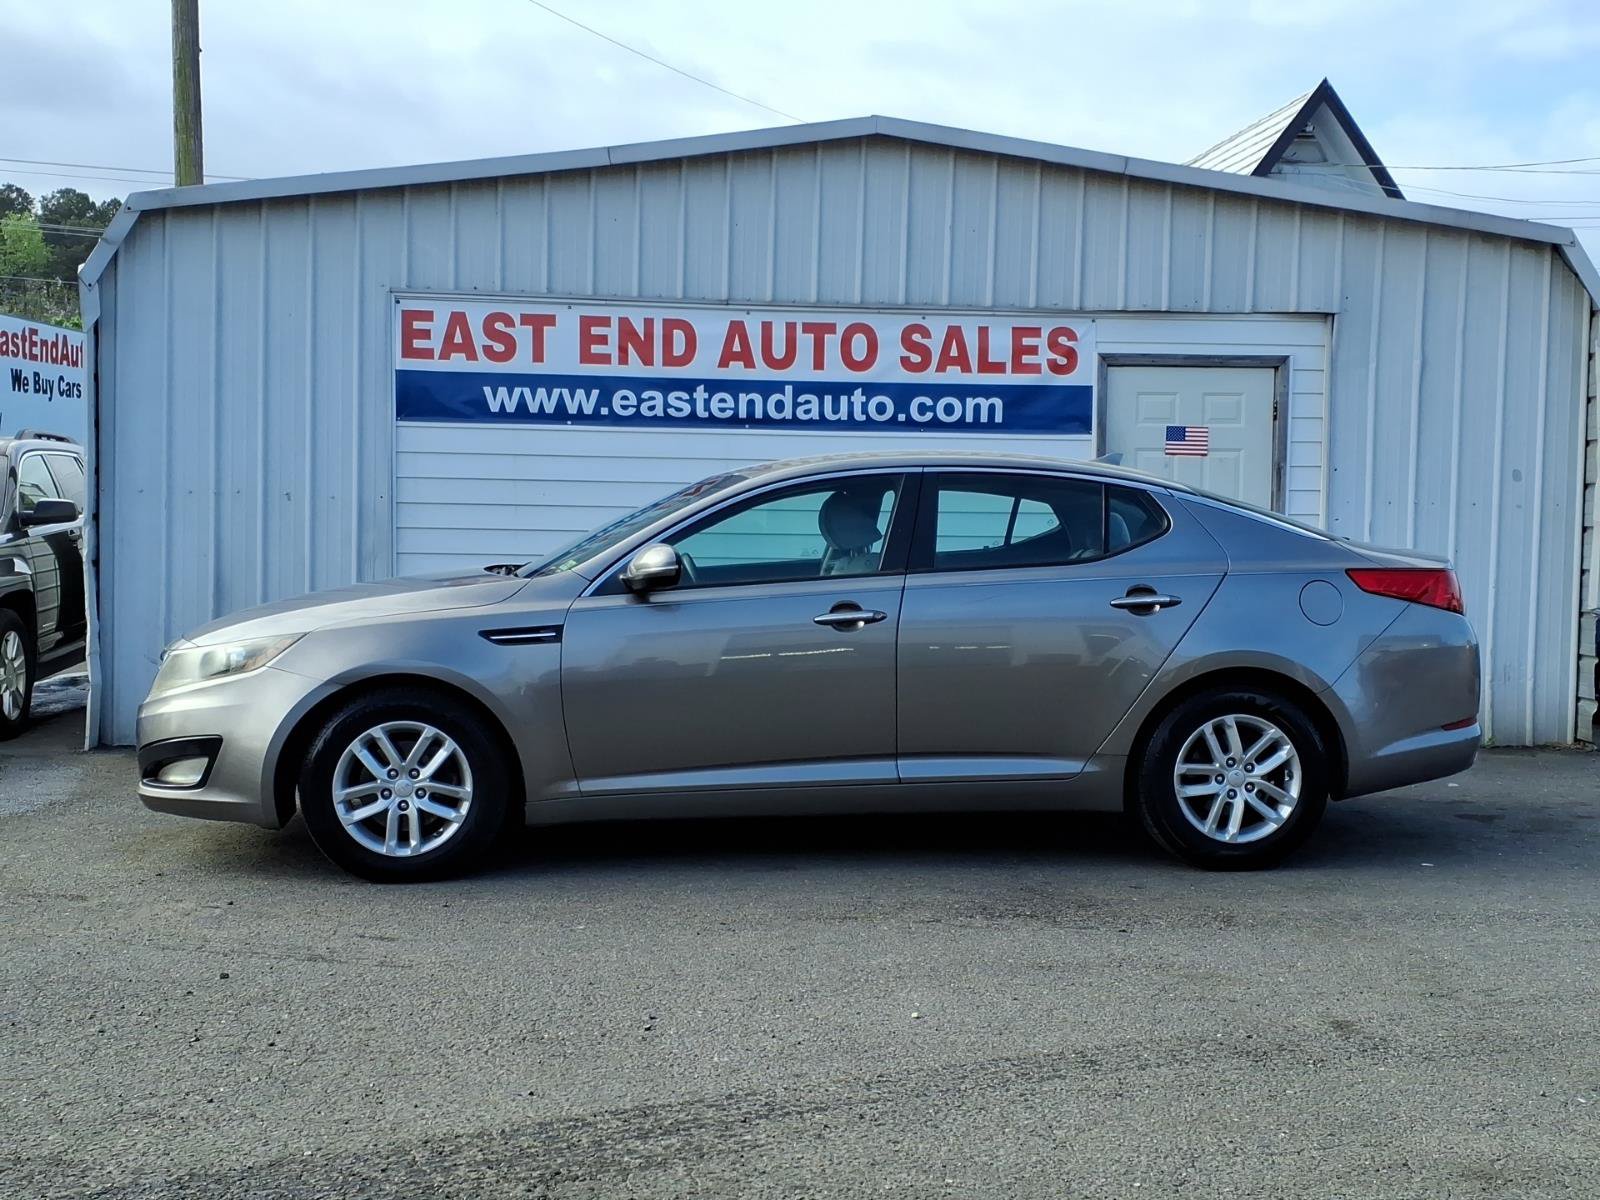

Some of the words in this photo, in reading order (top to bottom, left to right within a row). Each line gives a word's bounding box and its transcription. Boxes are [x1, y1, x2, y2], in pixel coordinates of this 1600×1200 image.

[401, 309, 556, 363] EAST
[579, 315, 698, 368] END
[717, 320, 879, 373] AUTO
[900, 323, 1079, 376] SALES
[10, 368, 29, 393] We
[33, 371, 54, 402] Buy
[58, 375, 82, 399] Cars
[483, 384, 1003, 424] www.eastendauto.com
